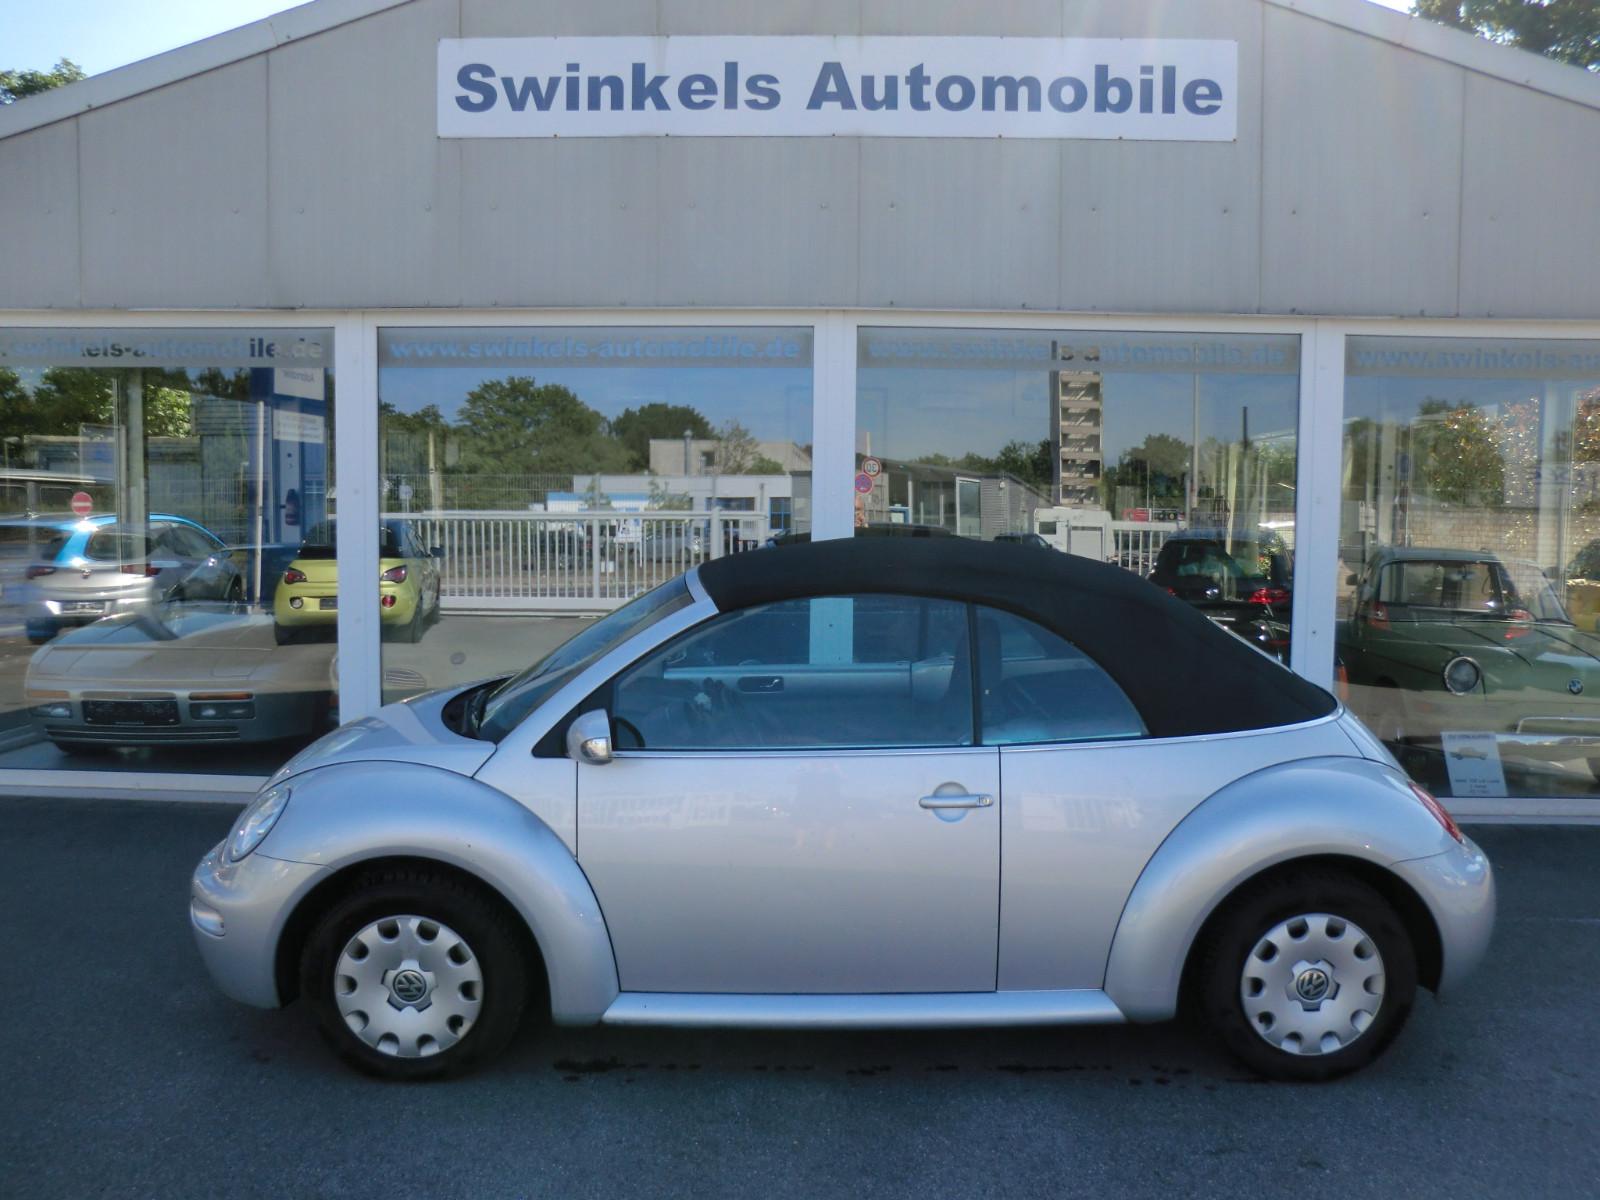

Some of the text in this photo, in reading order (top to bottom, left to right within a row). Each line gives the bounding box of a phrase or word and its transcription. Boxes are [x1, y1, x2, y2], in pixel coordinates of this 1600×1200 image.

[454, 61, 1223, 116] Swinkels Automobile
[389, 336, 800, 359] www.swinkels-automobile.de
[869, 339, 1286, 364] www.swinkels-automobile.de
